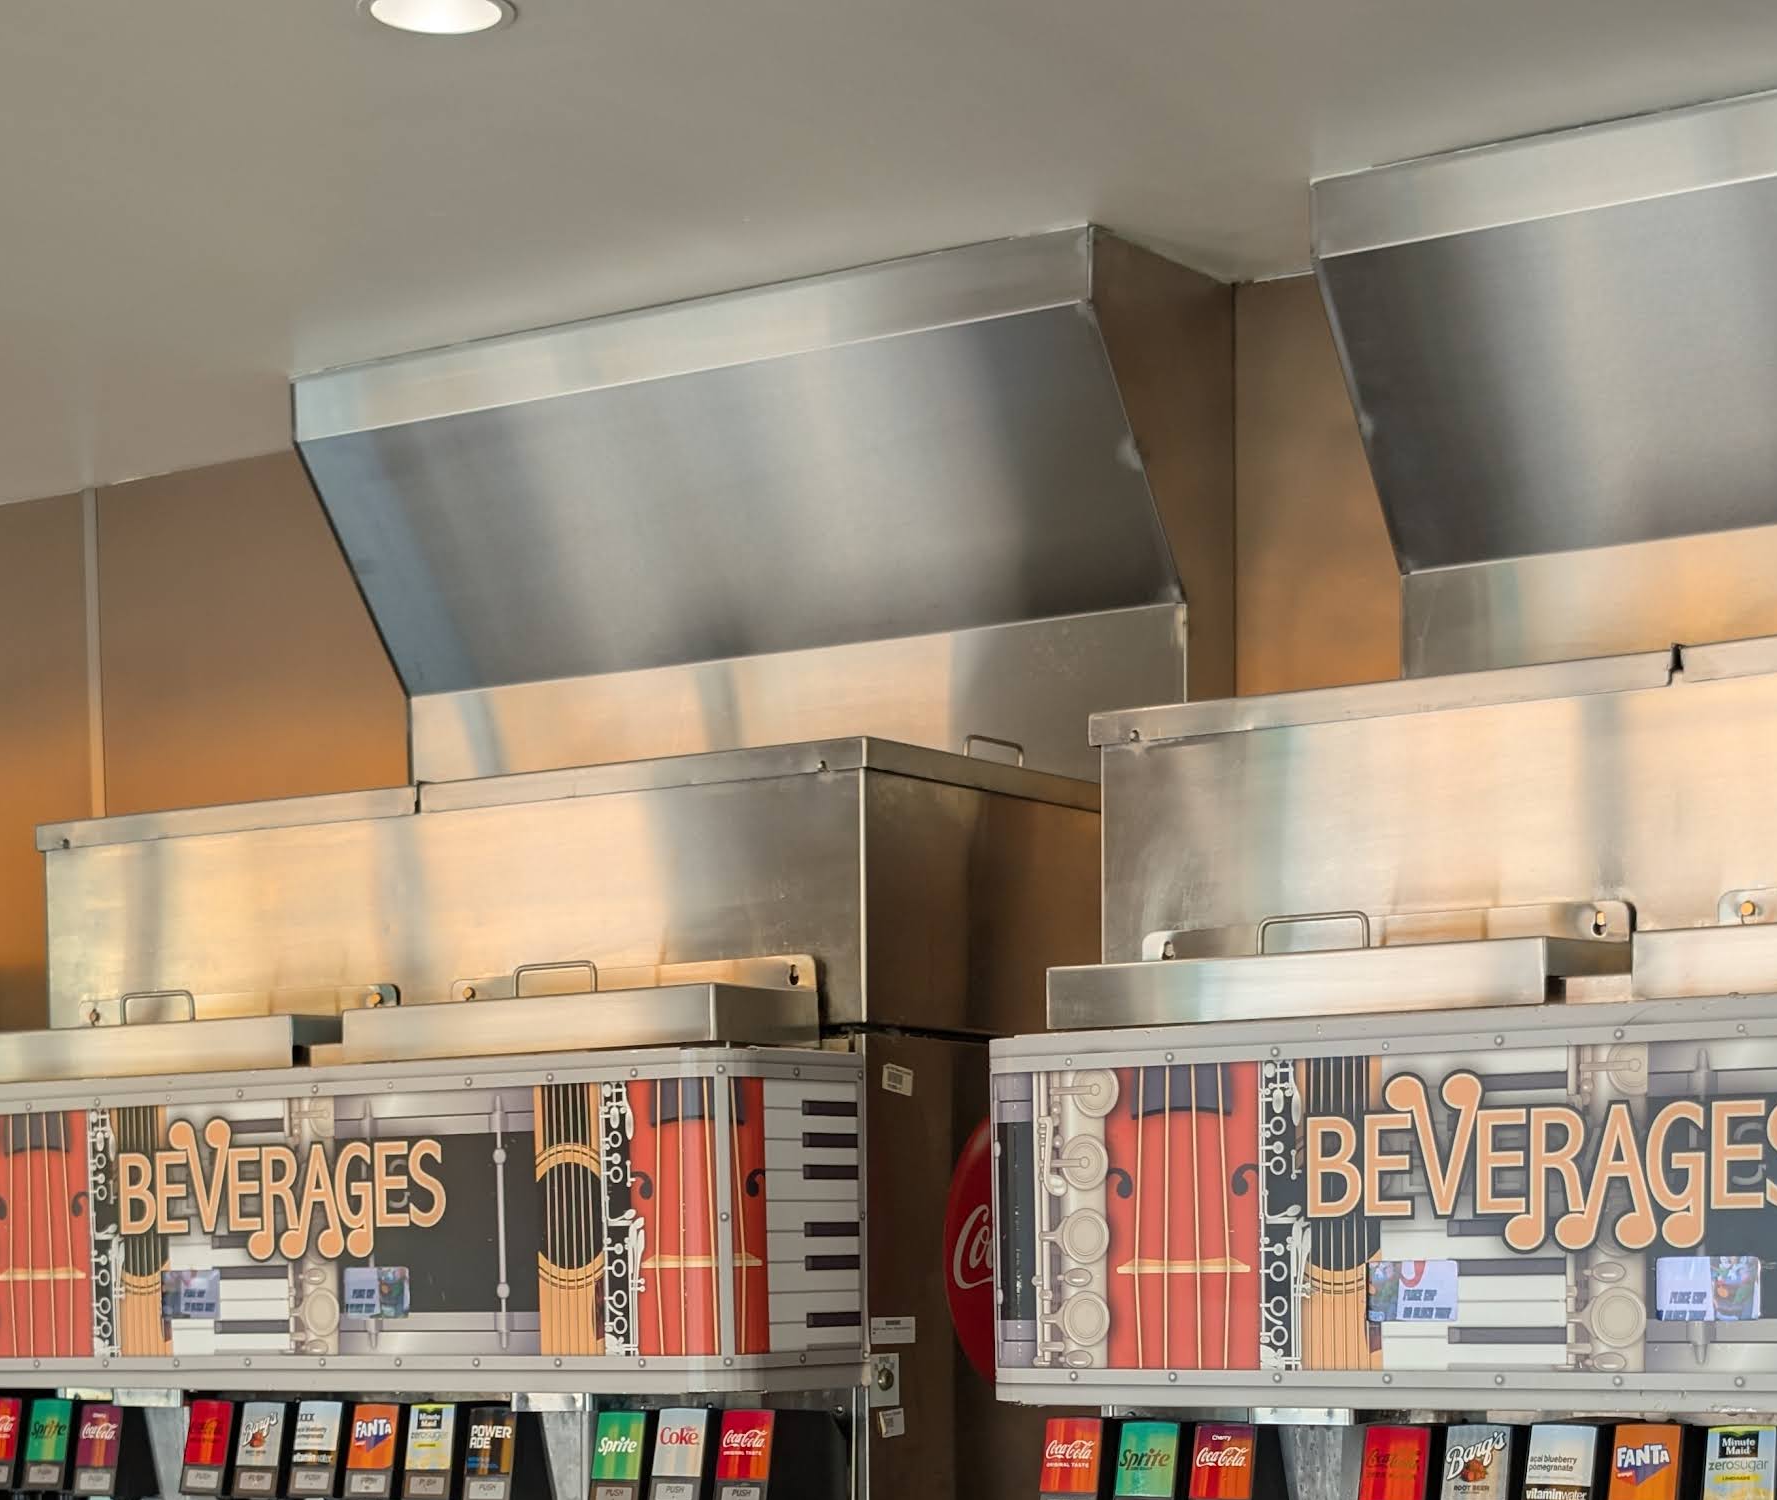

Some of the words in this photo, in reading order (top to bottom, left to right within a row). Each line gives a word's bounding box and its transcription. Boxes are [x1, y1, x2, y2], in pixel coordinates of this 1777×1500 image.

[118, 1117, 447, 1260] BEVERAGES
[30, 1419, 66, 1438] Sprite
[81, 1422, 119, 1440] Coca-Cola
[354, 1419, 392, 1440] FANTA
[471, 1425, 513, 1439] POWER
[660, 1426, 699, 1446] Coke
[469, 1436, 491, 1449] ADE
[598, 1436, 637, 1456] Sprite
[722, 1429, 768, 1449] Coca-Cola
[1721, 1437, 1756, 1449] Minute
[1046, 1439, 1094, 1460] Coca-Cola
[1196, 1446, 1249, 1467] Coca-Cola
[1445, 1431, 1507, 1481] Barq's
[1616, 1443, 1671, 1469] FANTA
[1725, 1445, 1752, 1456] Maid
[1119, 1448, 1171, 1471] Sprite
[1529, 1463, 1574, 1472] pomegranate
[1544, 1454, 1577, 1465] blueberry
[1708, 1457, 1769, 1473] zerosugar
[665, 1486, 685, 1494] PUSH
[731, 1488, 751, 1498] PUSH
